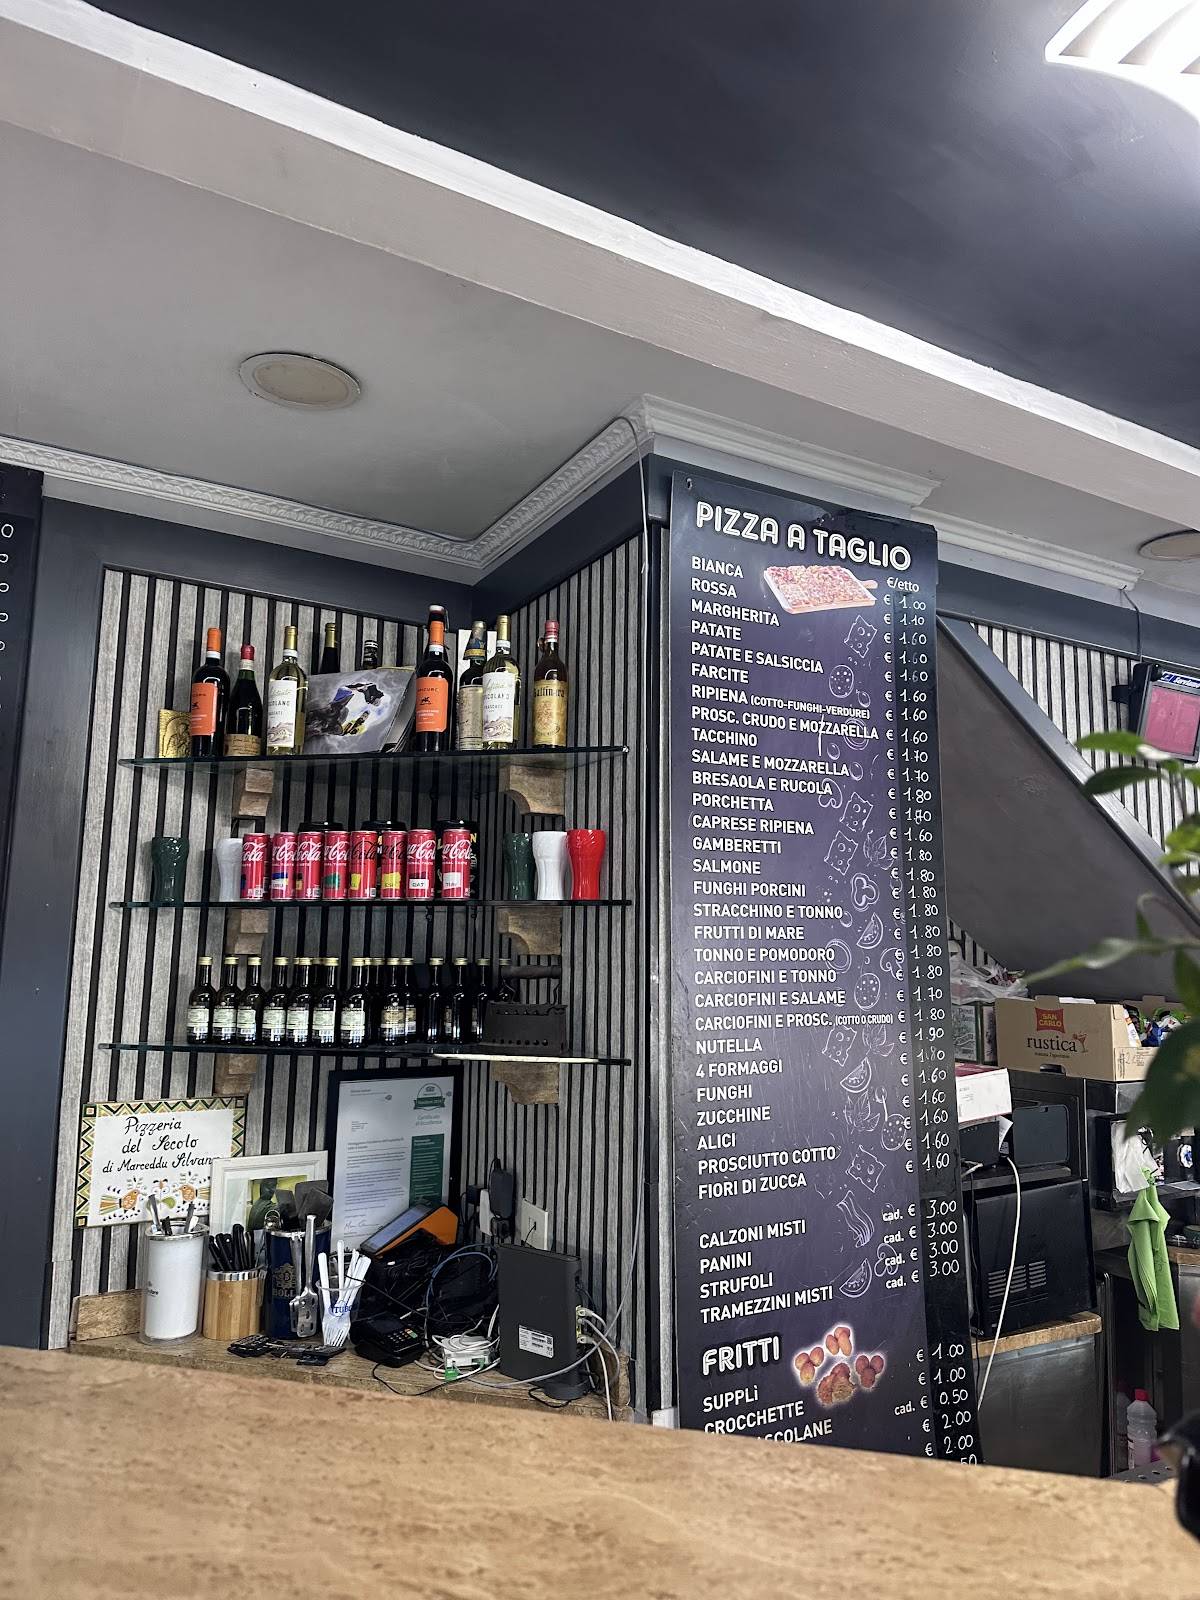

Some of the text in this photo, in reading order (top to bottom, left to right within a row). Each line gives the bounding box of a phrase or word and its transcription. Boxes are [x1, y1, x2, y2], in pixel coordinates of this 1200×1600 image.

[696, 501, 911, 571] PIZZA A TAGLIO
[691, 555, 744, 578] BIANCA
[691, 577, 737, 598] ROSSA
[886, 577, 920, 593] €/etto
[883, 594, 926, 610] € 1.00
[691, 599, 780, 627] MARGHERITA
[884, 614, 924, 625] € 1.10
[691, 620, 742, 640] PATATE
[899, 632, 927, 645] 1.60
[691, 642, 823, 674] PATATE E SALSICCIA
[899, 651, 927, 664] 1.60
[691, 663, 749, 684] FARCITE
[691, 684, 870, 719] RIPIENA (COTTO-FUNGHI-VERDURE)
[885, 689, 927, 702] € 1.60
[691, 706, 879, 740] PROSC. CRUDO E MOZZARELLA
[901, 708, 927, 721] 1.60
[691, 728, 758, 747] TACCHINO
[901, 728, 928, 744] 1.60
[692, 749, 849, 777] SALAME E MOZZARELLA
[886, 748, 928, 762] € 1.70
[692, 771, 833, 795] BRESAOLA E RUCOLA
[902, 767, 929, 782] 1.70
[692, 793, 774, 812] PORCHETTA
[903, 787, 931, 803] 1.80
[889, 808, 897, 819] €
[692, 815, 814, 835] CAPRESE RIPIENA
[904, 827, 933, 842] 1.60
[692, 837, 782, 854] GAMBERETTI
[905, 847, 932, 861] 1.80
[693, 859, 761, 875] SALMONE
[906, 867, 934, 882] 1.80
[693, 881, 806, 897] FUNGHI PORCINI
[908, 885, 936, 898] 1.80
[693, 903, 843, 919] STRACCHINO E TONNO
[908, 903, 938, 917] 1.80
[694, 926, 805, 940] FRUTTI DI MARE
[910, 925, 940, 939] 1.80
[694, 948, 835, 962] TONNO E POMODORO
[910, 944, 942, 959] 1.80
[694, 969, 837, 985] CARCIOFINI E TONNO
[912, 965, 942, 979] 1.80
[695, 990, 846, 1008] CARCIOFINI E SALAME
[913, 986, 942, 1001] 1.70
[695, 1015, 772, 1031] CARCIOFINI
[775, 1015, 784, 1028] E
[786, 1013, 833, 1027] PROSC.
[835, 1014, 860, 1026] (COTTO
[867, 1014, 893, 1025] CRUDO)
[914, 1008, 945, 1021] 1.80
[915, 1027, 944, 1041] 1.90
[696, 1037, 763, 1055] NUTELLA
[1027, 1035, 1077, 1052] rustica
[696, 1059, 783, 1078] 4 FORMAGGI
[918, 1067, 946, 1083] 1.60
[697, 1085, 752, 1102] FUNGHI
[902, 1095, 910, 1107] €
[918, 1089, 945, 1104] 1.60
[697, 1106, 771, 1127] ZUCCHINE
[920, 1108, 948, 1126] 1.60
[124, 1116, 182, 1137] Pizzeria
[121, 1134, 198, 1154] del Secolo
[697, 1132, 736, 1151] ALICI
[921, 1131, 949, 1149] 1.60
[102, 1151, 221, 1173] di Marceddu Silvan
[698, 1146, 836, 1175] PROSCIUTTO COTTO
[922, 1153, 949, 1171] 1.60
[698, 1173, 807, 1200] FIORI DI ZUCCA
[882, 1200, 956, 1222] cad. € 3.00
[699, 1219, 806, 1250] CALZONI MISTI
[883, 1221, 957, 1244] cad. € 3.00
[884, 1239, 958, 1266] cad. € 3.00
[700, 1251, 752, 1274] PANINI
[885, 1259, 959, 1289] cad. € 3.00
[700, 1272, 773, 1299] STRUFOLI
[700, 1285, 833, 1324] TRAMEZZINI MISTI
[702, 1336, 780, 1376] FRITTI
[916, 1343, 964, 1362] € 1.00
[918, 1367, 966, 1385] € 1.00
[894, 1404, 915, 1416] cad.
[920, 1396, 928, 1409] €
[704, 1400, 804, 1434] CROCCHETTE
[922, 1411, 971, 1433] € 2.00
[757, 1419, 833, 1443] COLANE
[925, 1435, 973, 1456] € 2.00
